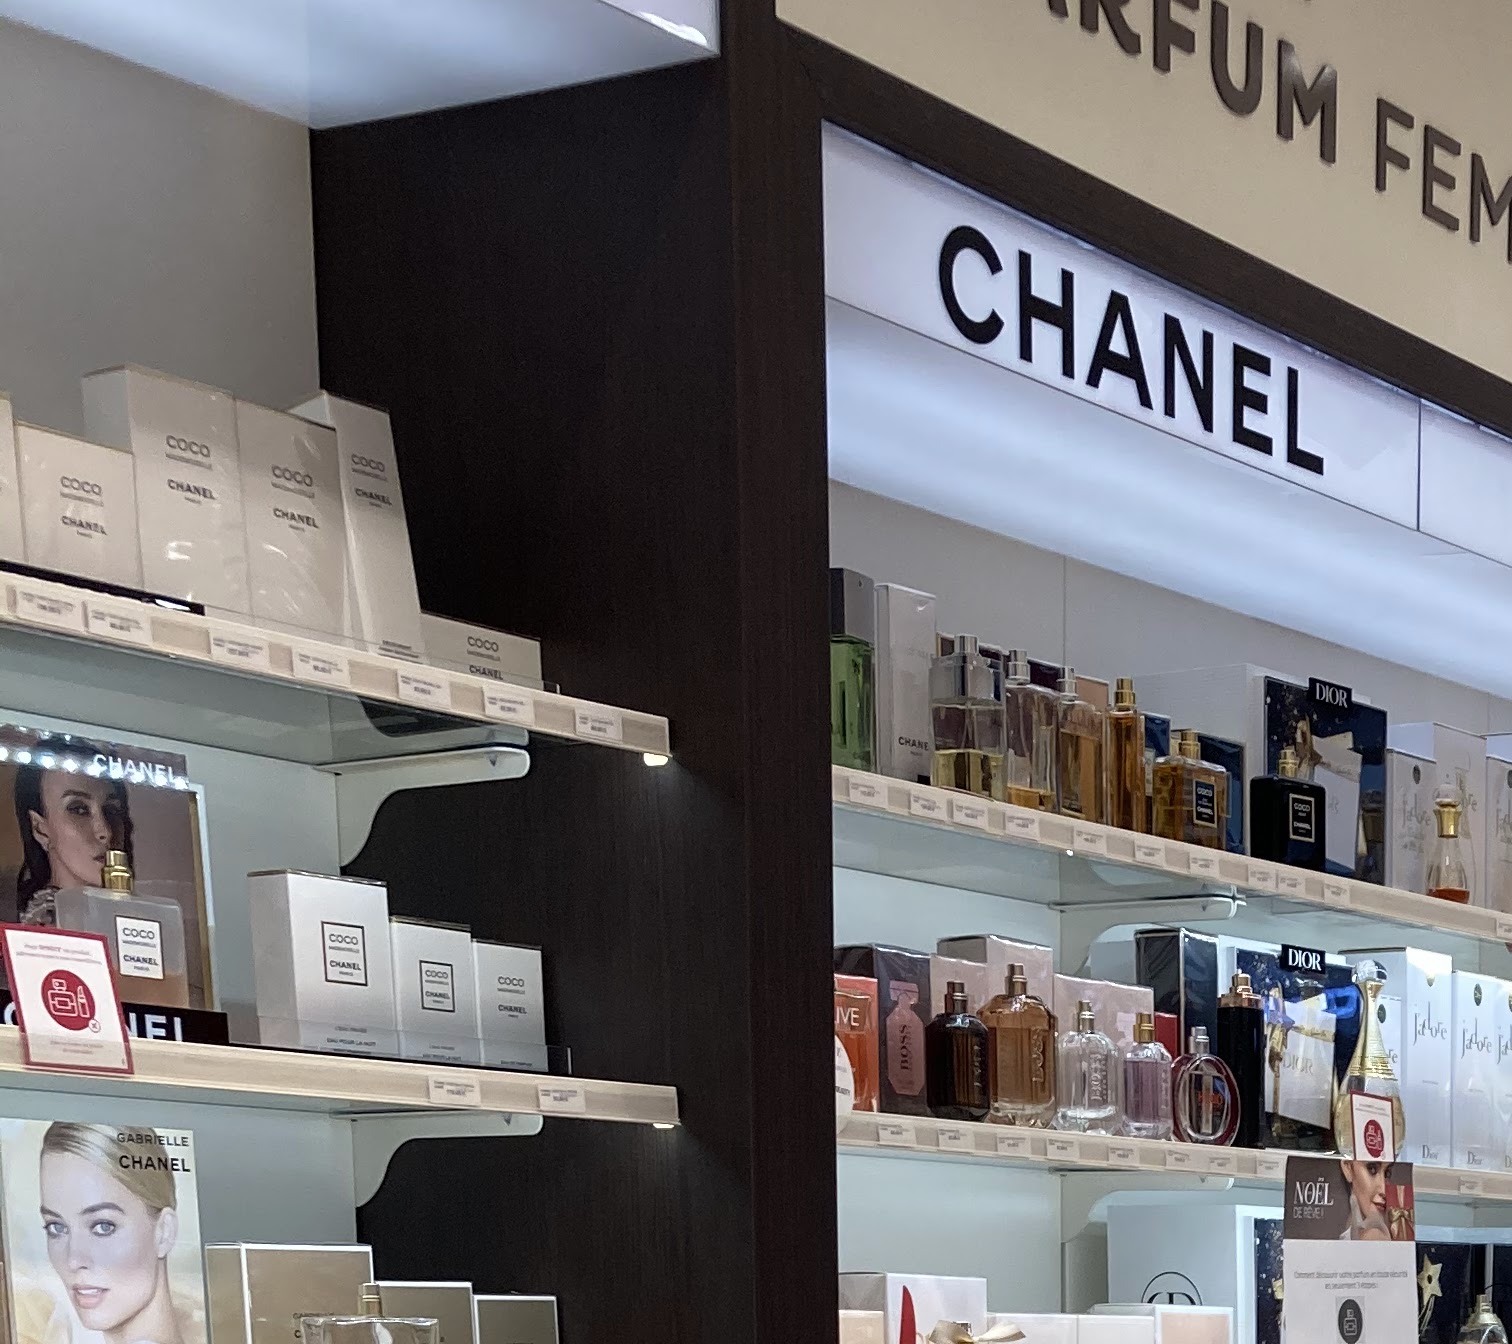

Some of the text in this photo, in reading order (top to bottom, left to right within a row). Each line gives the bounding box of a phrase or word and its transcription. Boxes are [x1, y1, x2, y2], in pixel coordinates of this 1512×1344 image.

[938, 225, 1325, 477] CHANEL
[166, 434, 211, 458] COCO
[351, 453, 386, 473] COCO
[271, 465, 314, 487] COCO
[60, 476, 103, 497] COCO
[168, 479, 217, 500] CHANEL
[355, 487, 394, 506] CHANEL
[61, 515, 108, 536] CHANEL
[273, 507, 320, 529] CHANEL
[467, 635, 499, 653] COCO
[469, 665, 504, 681] CHANEL
[1315, 683, 1349, 709] DIOR
[898, 736, 930, 752] CHANE
[122, 926, 156, 940] COCO
[328, 933, 360, 946] COCO
[123, 953, 160, 967] CHANEL
[329, 959, 362, 971] CHANEL
[1288, 948, 1321, 971] DIOR
[424, 968, 449, 981] COCO
[496, 975, 526, 988] COCO
[497, 1003, 528, 1015] CHANEL
[834, 1005, 860, 1027] IVE
[898, 1023, 911, 1073] BOSS
[116, 1131, 190, 1149] GABRIELLE
[118, 1154, 191, 1173] CHANEL
[1293, 1177, 1334, 1206] NOËL
